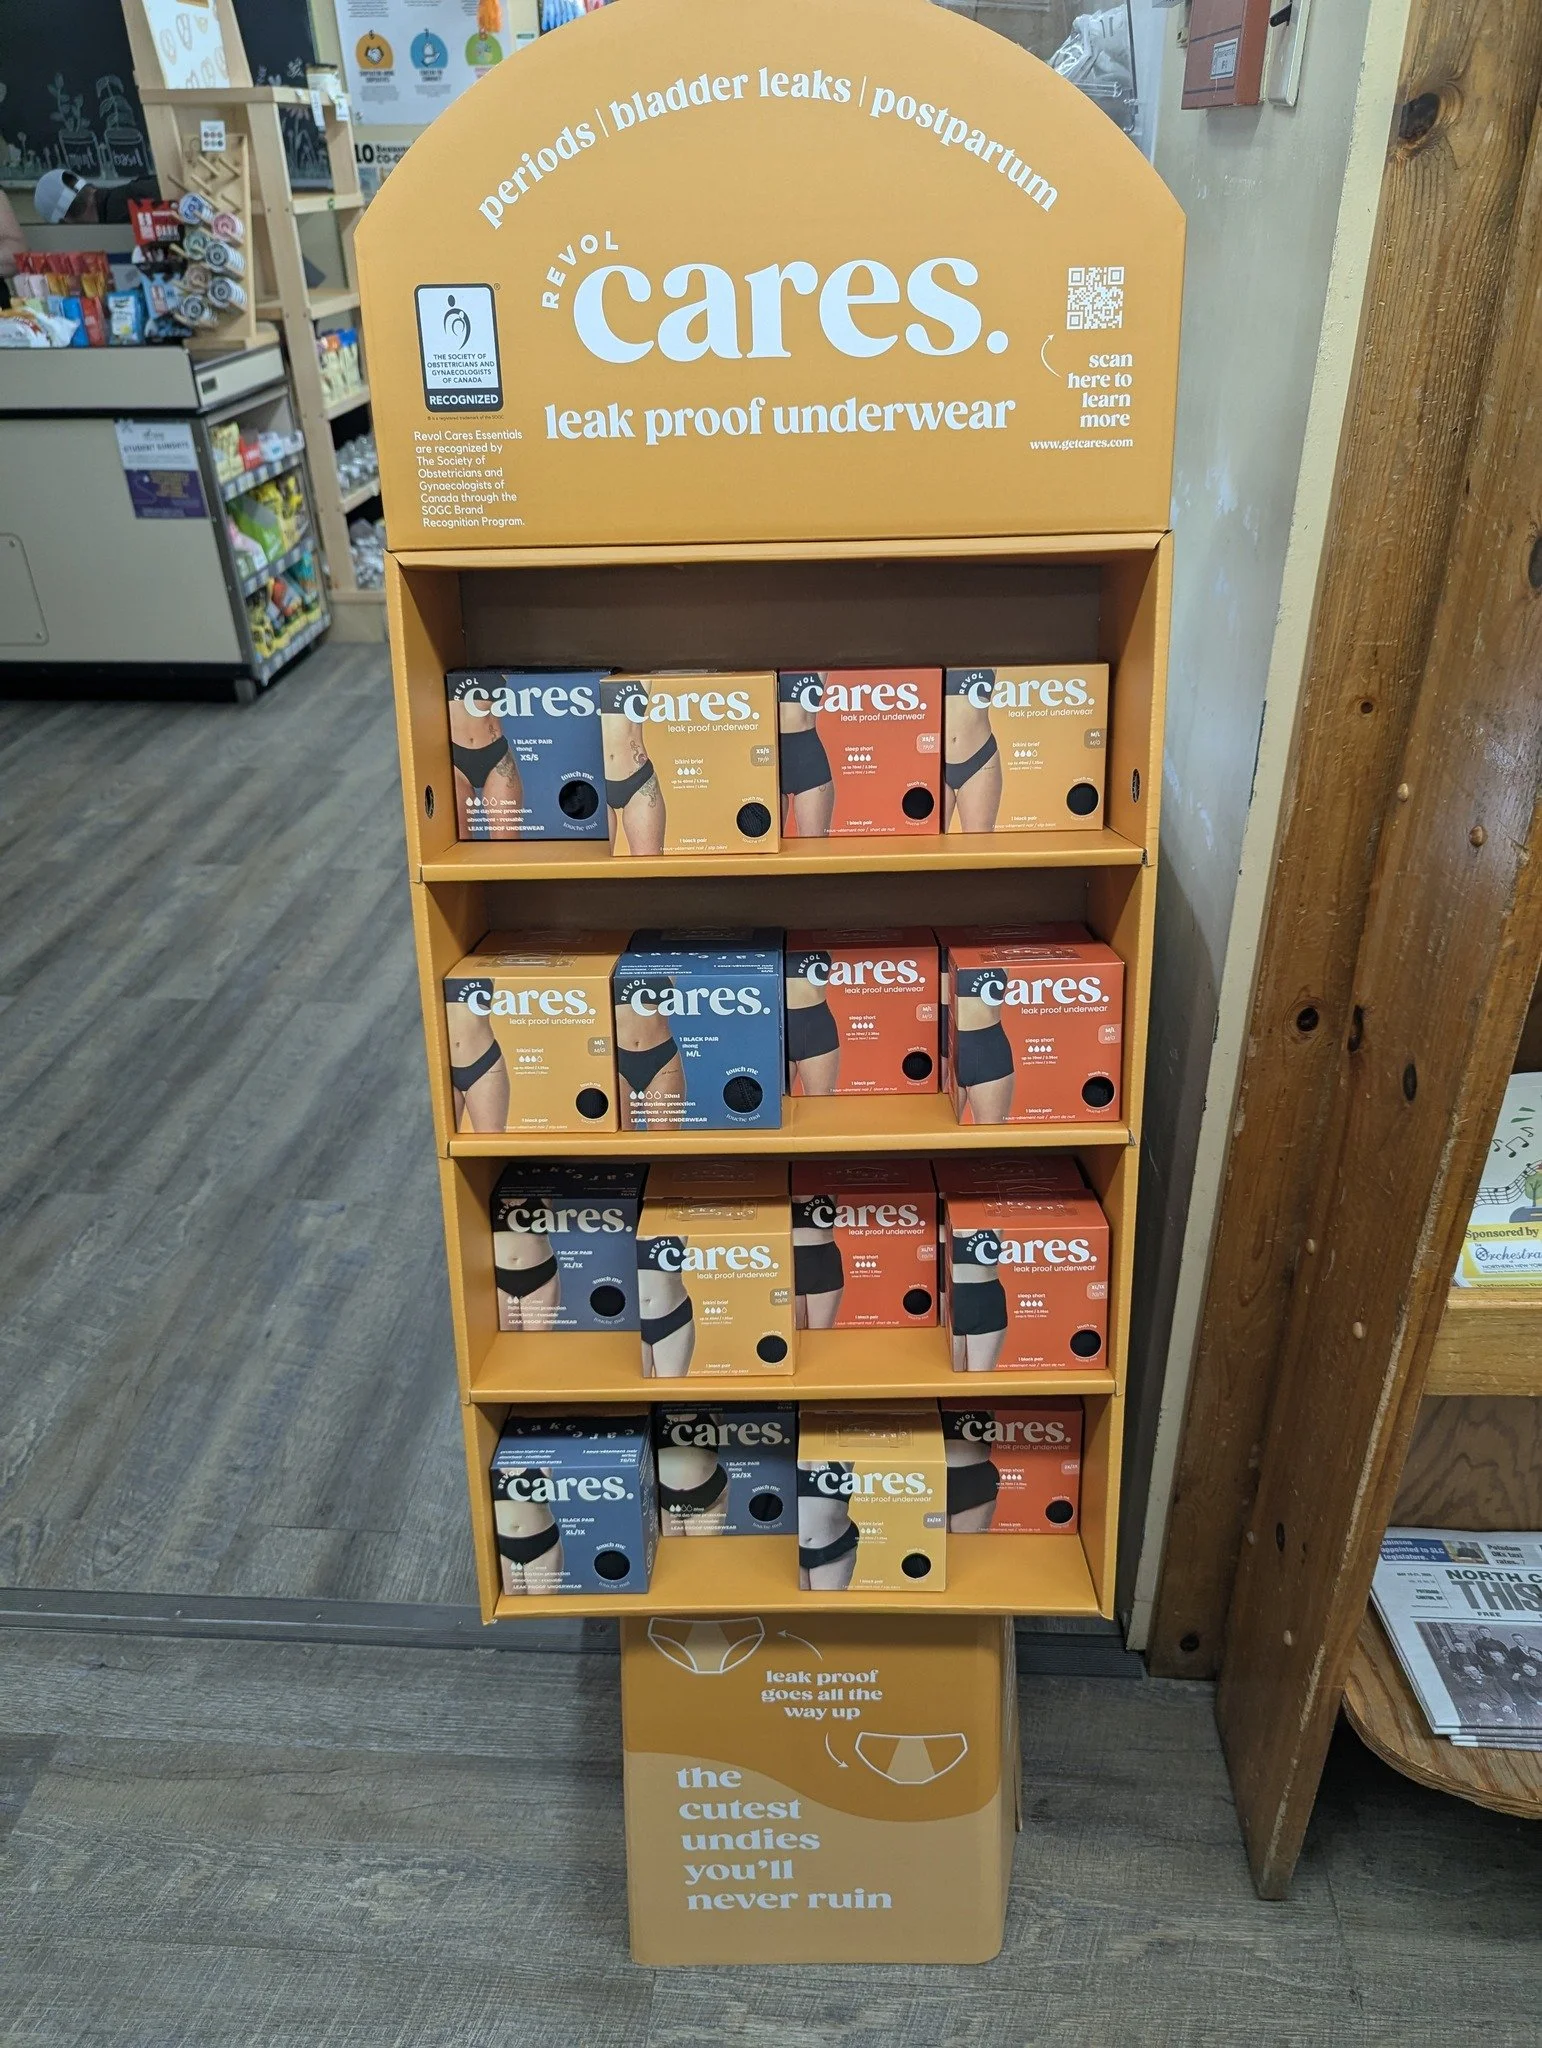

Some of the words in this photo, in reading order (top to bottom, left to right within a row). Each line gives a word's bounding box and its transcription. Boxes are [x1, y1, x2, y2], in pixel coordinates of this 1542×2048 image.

[478, 122, 596, 230] periods
[609, 73, 748, 131] bladder
[758, 66, 852, 103] leaks
[869, 87, 1059, 213] postpartum
[541, 231, 619, 309] REVOL
[574, 258, 1009, 363] cares.
[1089, 353, 1132, 368] scan
[1067, 372, 1110, 388] here
[1114, 372, 1132, 387] to
[430, 395, 498, 405] RECOGNIZED
[1082, 392, 1131, 407] learn
[544, 403, 636, 440] leak
[644, 397, 766, 445] proof
[773, 397, 1016, 435] underwear
[1080, 413, 1130, 427] more
[414, 431, 442, 441] Revol
[445, 431, 473, 440] Cares
[475, 429, 522, 439] Essentials
[1030, 439, 1133, 450] www.getcares.com
[435, 443, 488, 455] recognized
[491, 443, 503, 454] by
[416, 456, 435, 466] The
[437, 456, 473, 467] Society
[476, 455, 486, 464] of
[418, 468, 482, 478] Obstetricians
[485, 468, 503, 477] and
[419, 481, 492, 492] Gynaecologists
[495, 480, 505, 489] of
[421, 494, 459, 503] Canada
[461, 493, 499, 504] through
[502, 492, 517, 501] the
[422, 506, 452, 515] SOGC
[454, 505, 484, 514] Brand
[423, 518, 479, 529] Recognition
[482, 517, 525, 528] Program.
[454, 678, 479, 700] REVOL
[791, 676, 815, 698] REVOL
[959, 673, 983, 694] REVOL
[968, 679, 1094, 709] cares.
[464, 687, 601, 717] cares.
[614, 684, 638, 708] REVOL
[800, 684, 927, 713] cares.
[623, 691, 760, 724] cares.
[841, 714, 858, 722] leak
[859, 714, 880, 722] proof
[882, 713, 925, 721] underwear
[1027, 710, 1048, 718] proof
[688, 724, 710, 733] proof
[712, 723, 759, 732] underwear
[798, 954, 820, 974] REVOL
[807, 959, 926, 986] cares.
[458, 982, 482, 1002] REVOL
[621, 979, 647, 1001] REVOL
[862, 987, 882, 995] proof
[971, 972, 995, 993] REVOL
[980, 977, 1109, 1006] cares.
[468, 989, 596, 1016] cares.
[631, 987, 771, 1016] cares.
[1040, 1007, 1062, 1016] proof
[528, 1018, 550, 1026] proof
[507, 1208, 633, 1233] cares.
[812, 1204, 926, 1228] cares.
[966, 1232, 989, 1252] REVOL
[1465, 1227, 1524, 1240] Sponsored
[1525, 1227, 1539, 1237] by
[649, 1239, 672, 1258] REVOL
[658, 1245, 779, 1271] cares.
[975, 1239, 1097, 1265] cares.
[714, 1272, 735, 1280] proof
[671, 1422, 791, 1446] cares.
[962, 1420, 1071, 1443] cares.
[507, 1476, 634, 1501] cares.
[817, 1472, 933, 1494] cares.
[1445, 1570, 1523, 1582] NORTH
[1451, 1581, 1542, 1611] THIS
[767, 1669, 812, 1684] leak
[816, 1669, 879, 1686] proof
[760, 1688, 814, 1703] goes
[817, 1687, 843, 1701] all
[848, 1687, 883, 1701] the
[783, 1706, 828, 1720] way
[831, 1706, 861, 1720] up
[675, 1766, 742, 1789] the
[678, 1798, 802, 1821] cutest
[681, 1828, 821, 1851] undies
[683, 1858, 795, 1886] you'll
[687, 1891, 798, 1910] never
[807, 1888, 893, 1909] ruin
